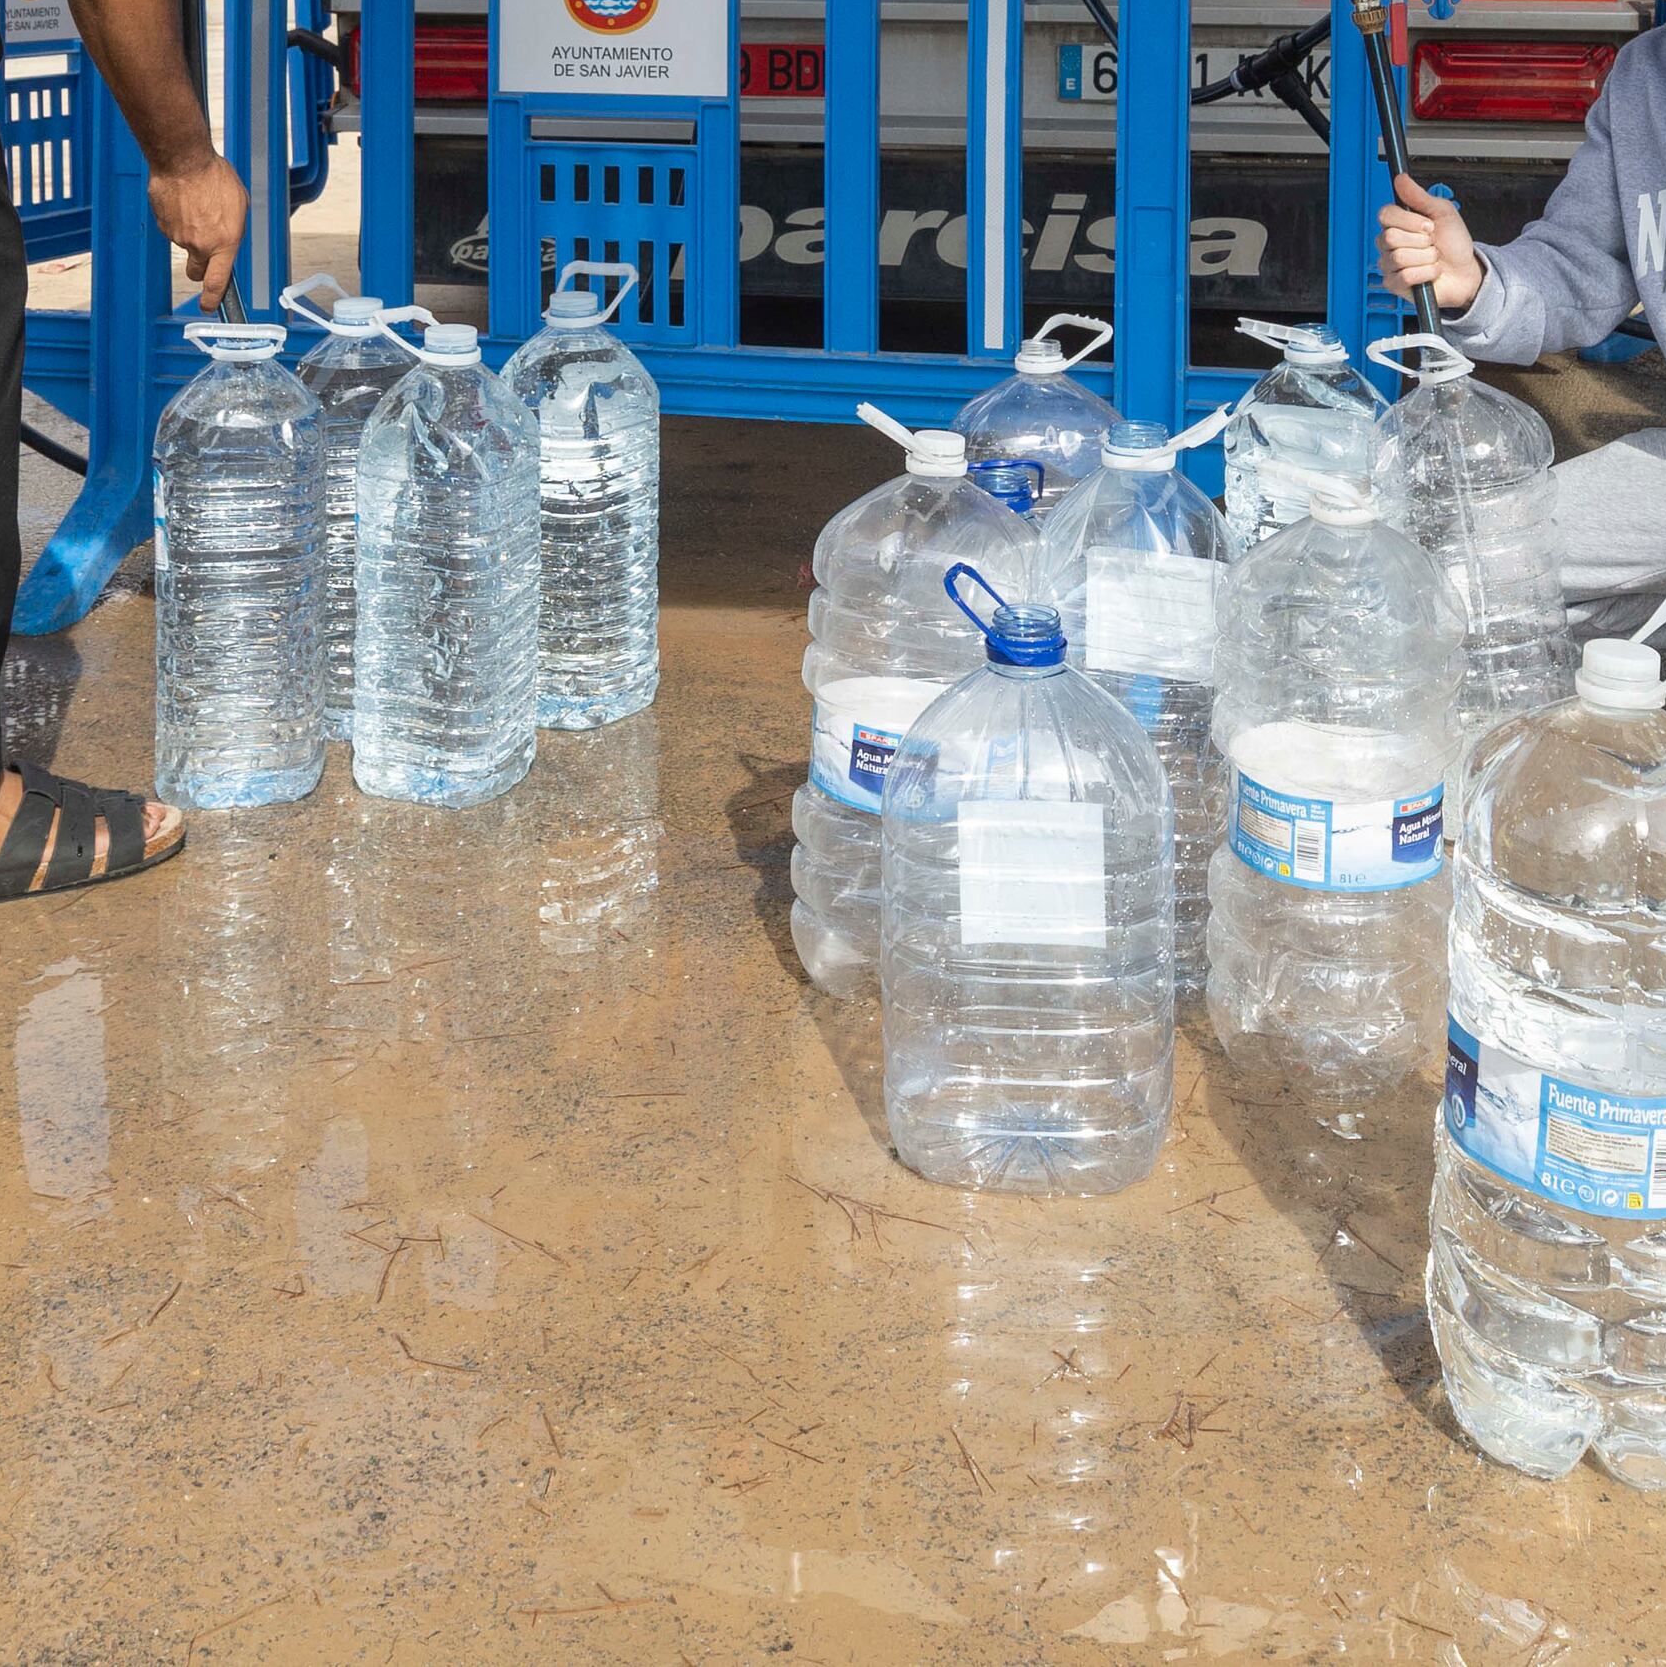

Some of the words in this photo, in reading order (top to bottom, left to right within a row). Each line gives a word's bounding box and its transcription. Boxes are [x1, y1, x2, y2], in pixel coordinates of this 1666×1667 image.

[6, 7, 60, 19] YUNTAMIENTO
[551, 45, 674, 61] AYUNTAMIENTO
[554, 63, 575, 77] DE
[579, 64, 611, 77] SAN
[615, 64, 670, 79] JAVIER
[768, 49, 826, 92] BD
[1093, 50, 1209, 94] 61
[1065, 77, 1077, 91] E
[856, 748, 882, 764] Agua
[855, 759, 890, 775] Natura
[1261, 790, 1308, 819] Primavera
[1399, 821, 1421, 835] Agua
[1399, 827, 1430, 846] Natural
[1548, 1082, 1597, 1118] Fuente
